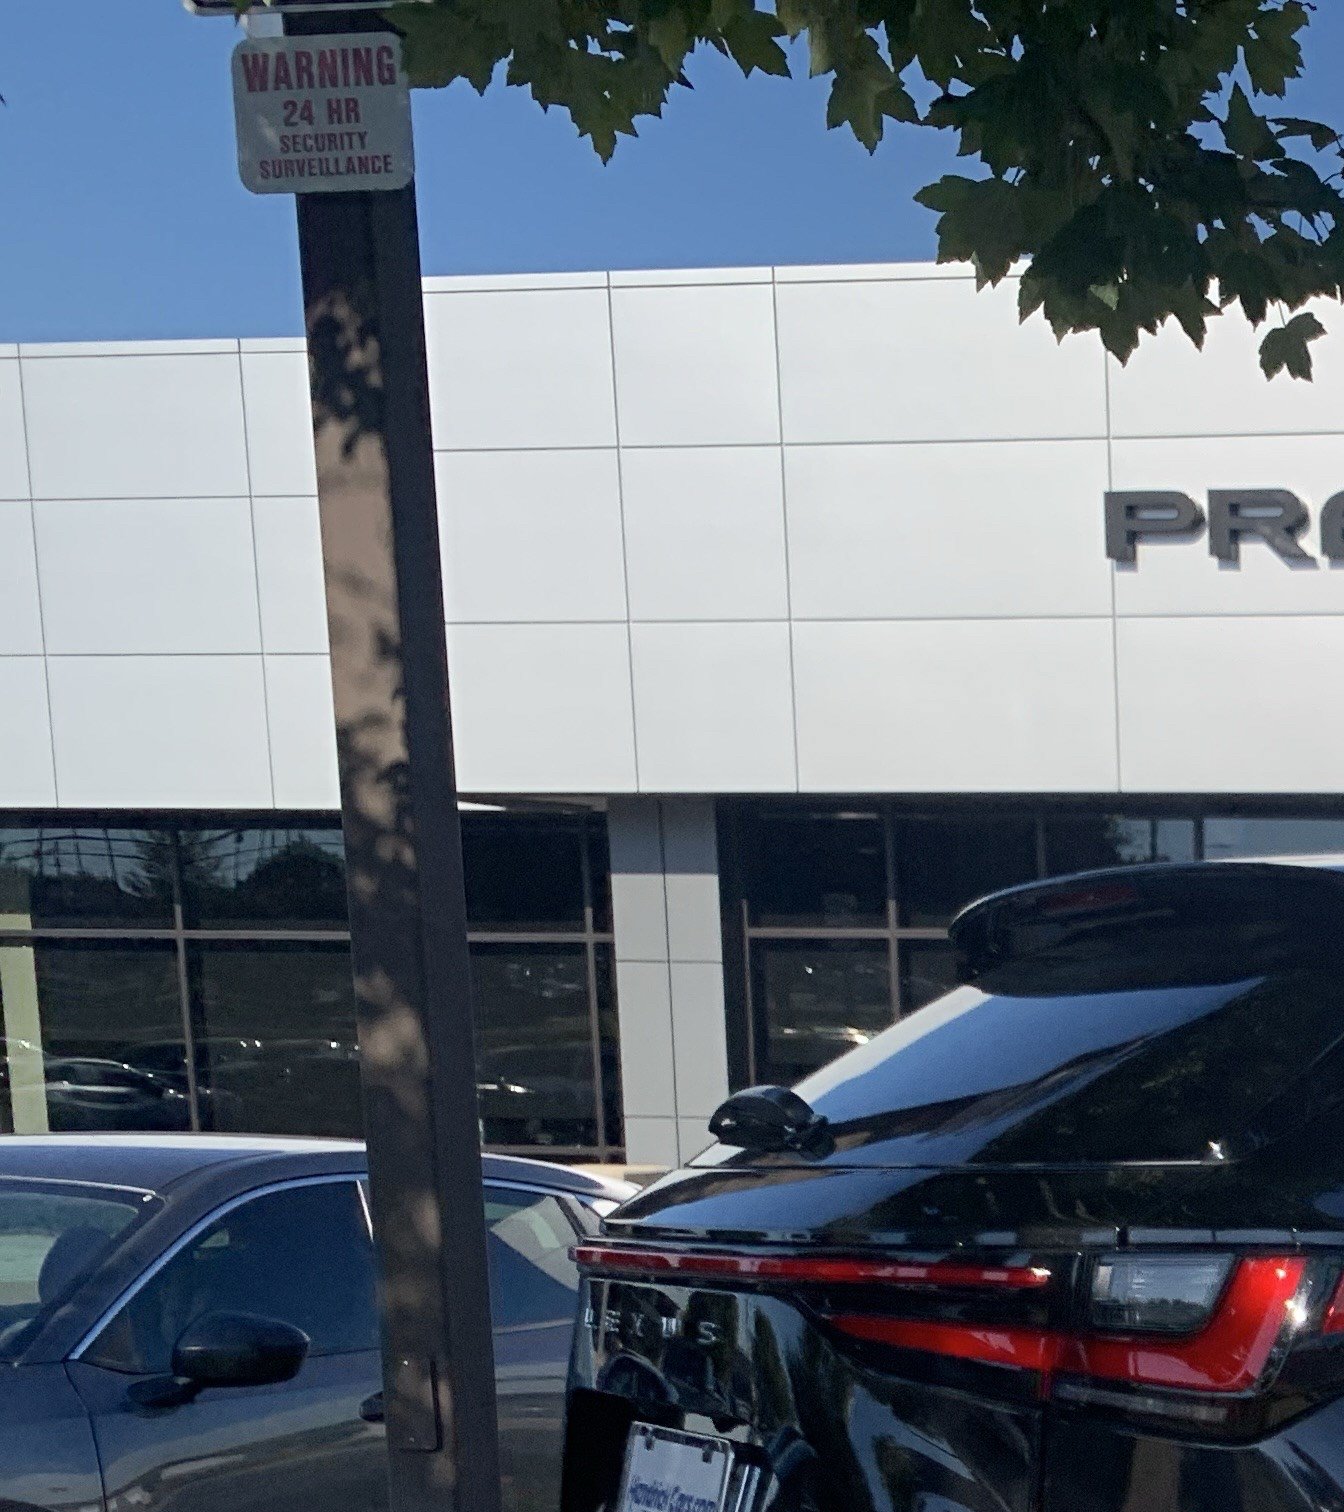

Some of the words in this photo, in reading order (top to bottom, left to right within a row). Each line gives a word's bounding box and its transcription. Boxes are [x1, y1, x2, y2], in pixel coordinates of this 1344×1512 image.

[241, 45, 396, 93] WARNING
[283, 99, 315, 127] 24
[327, 97, 361, 125] HR
[279, 131, 368, 153] SECURITY
[259, 154, 394, 179] SURVEILLANCE
[584, 1307, 722, 1345] LEXUS
